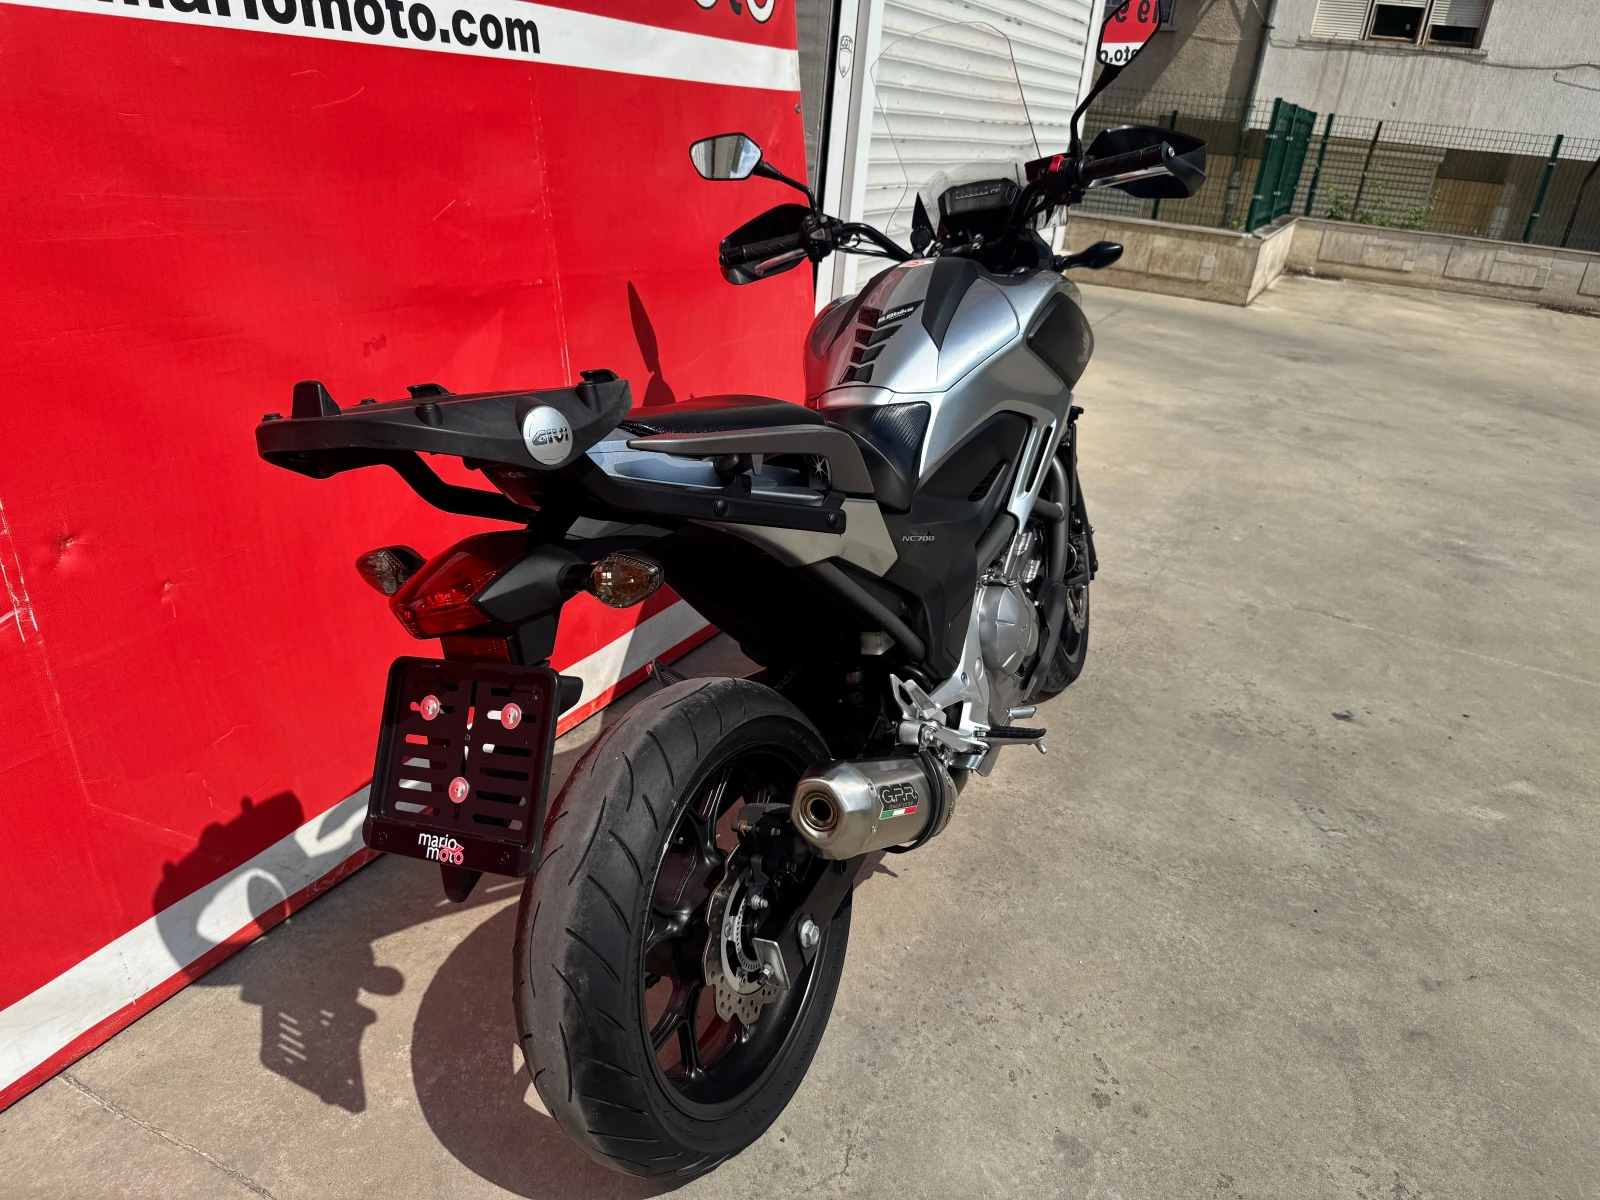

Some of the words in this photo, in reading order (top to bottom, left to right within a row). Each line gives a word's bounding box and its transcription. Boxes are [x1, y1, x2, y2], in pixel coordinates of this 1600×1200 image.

[531, 426, 569, 446] GIVI
[417, 832, 457, 850] mario
[425, 846, 464, 866] moto
